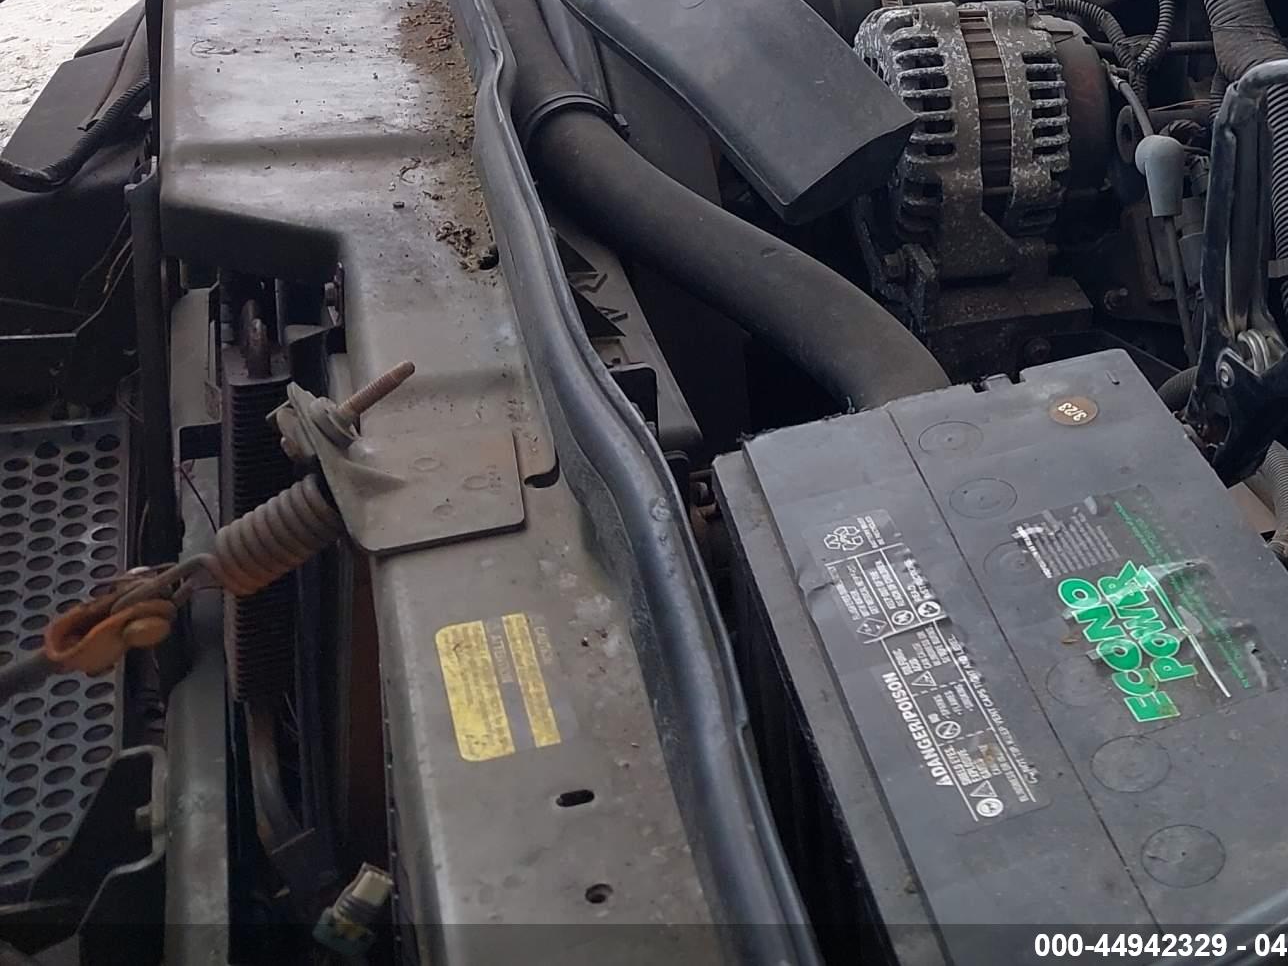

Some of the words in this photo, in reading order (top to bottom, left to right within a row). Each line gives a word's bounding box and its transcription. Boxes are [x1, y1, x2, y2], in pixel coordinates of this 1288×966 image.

[1057, 402, 1088, 422] 3/23
[1057, 577, 1181, 722] ECONO
[1097, 560, 1198, 681] POWER
[881, 670, 946, 777] DANGER/POISON
[977, 688, 993, 708] CAPS
